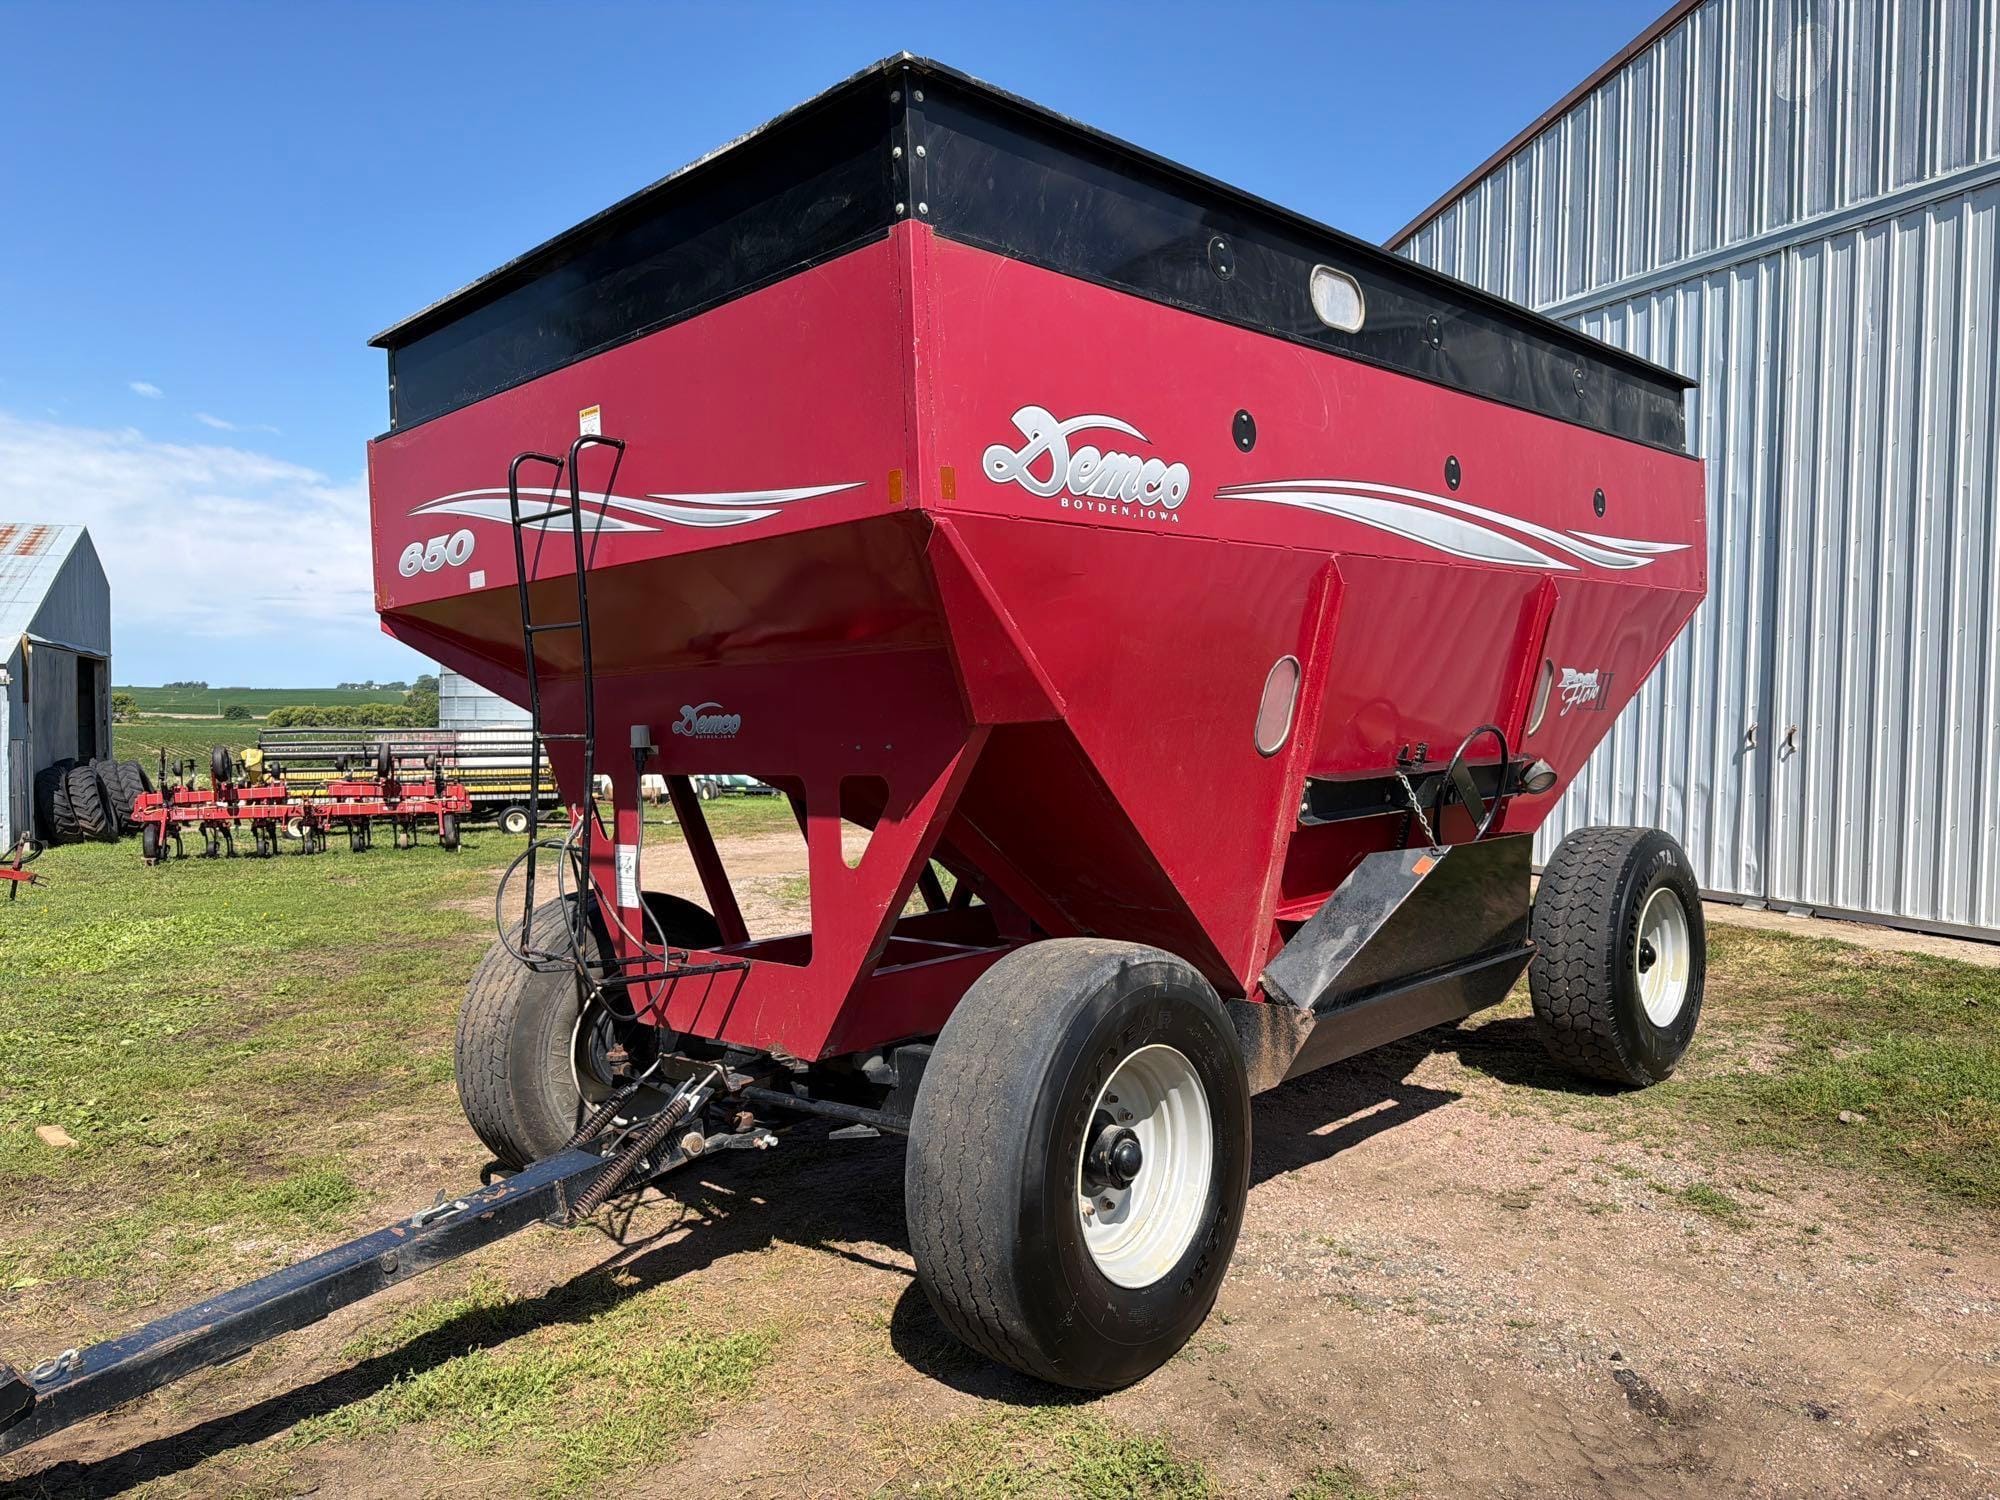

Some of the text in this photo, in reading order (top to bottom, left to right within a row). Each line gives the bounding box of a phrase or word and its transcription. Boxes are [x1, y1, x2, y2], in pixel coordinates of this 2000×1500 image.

[982, 405, 1190, 509] Demco
[399, 529, 475, 577] 650
[672, 702, 741, 737] Demco
